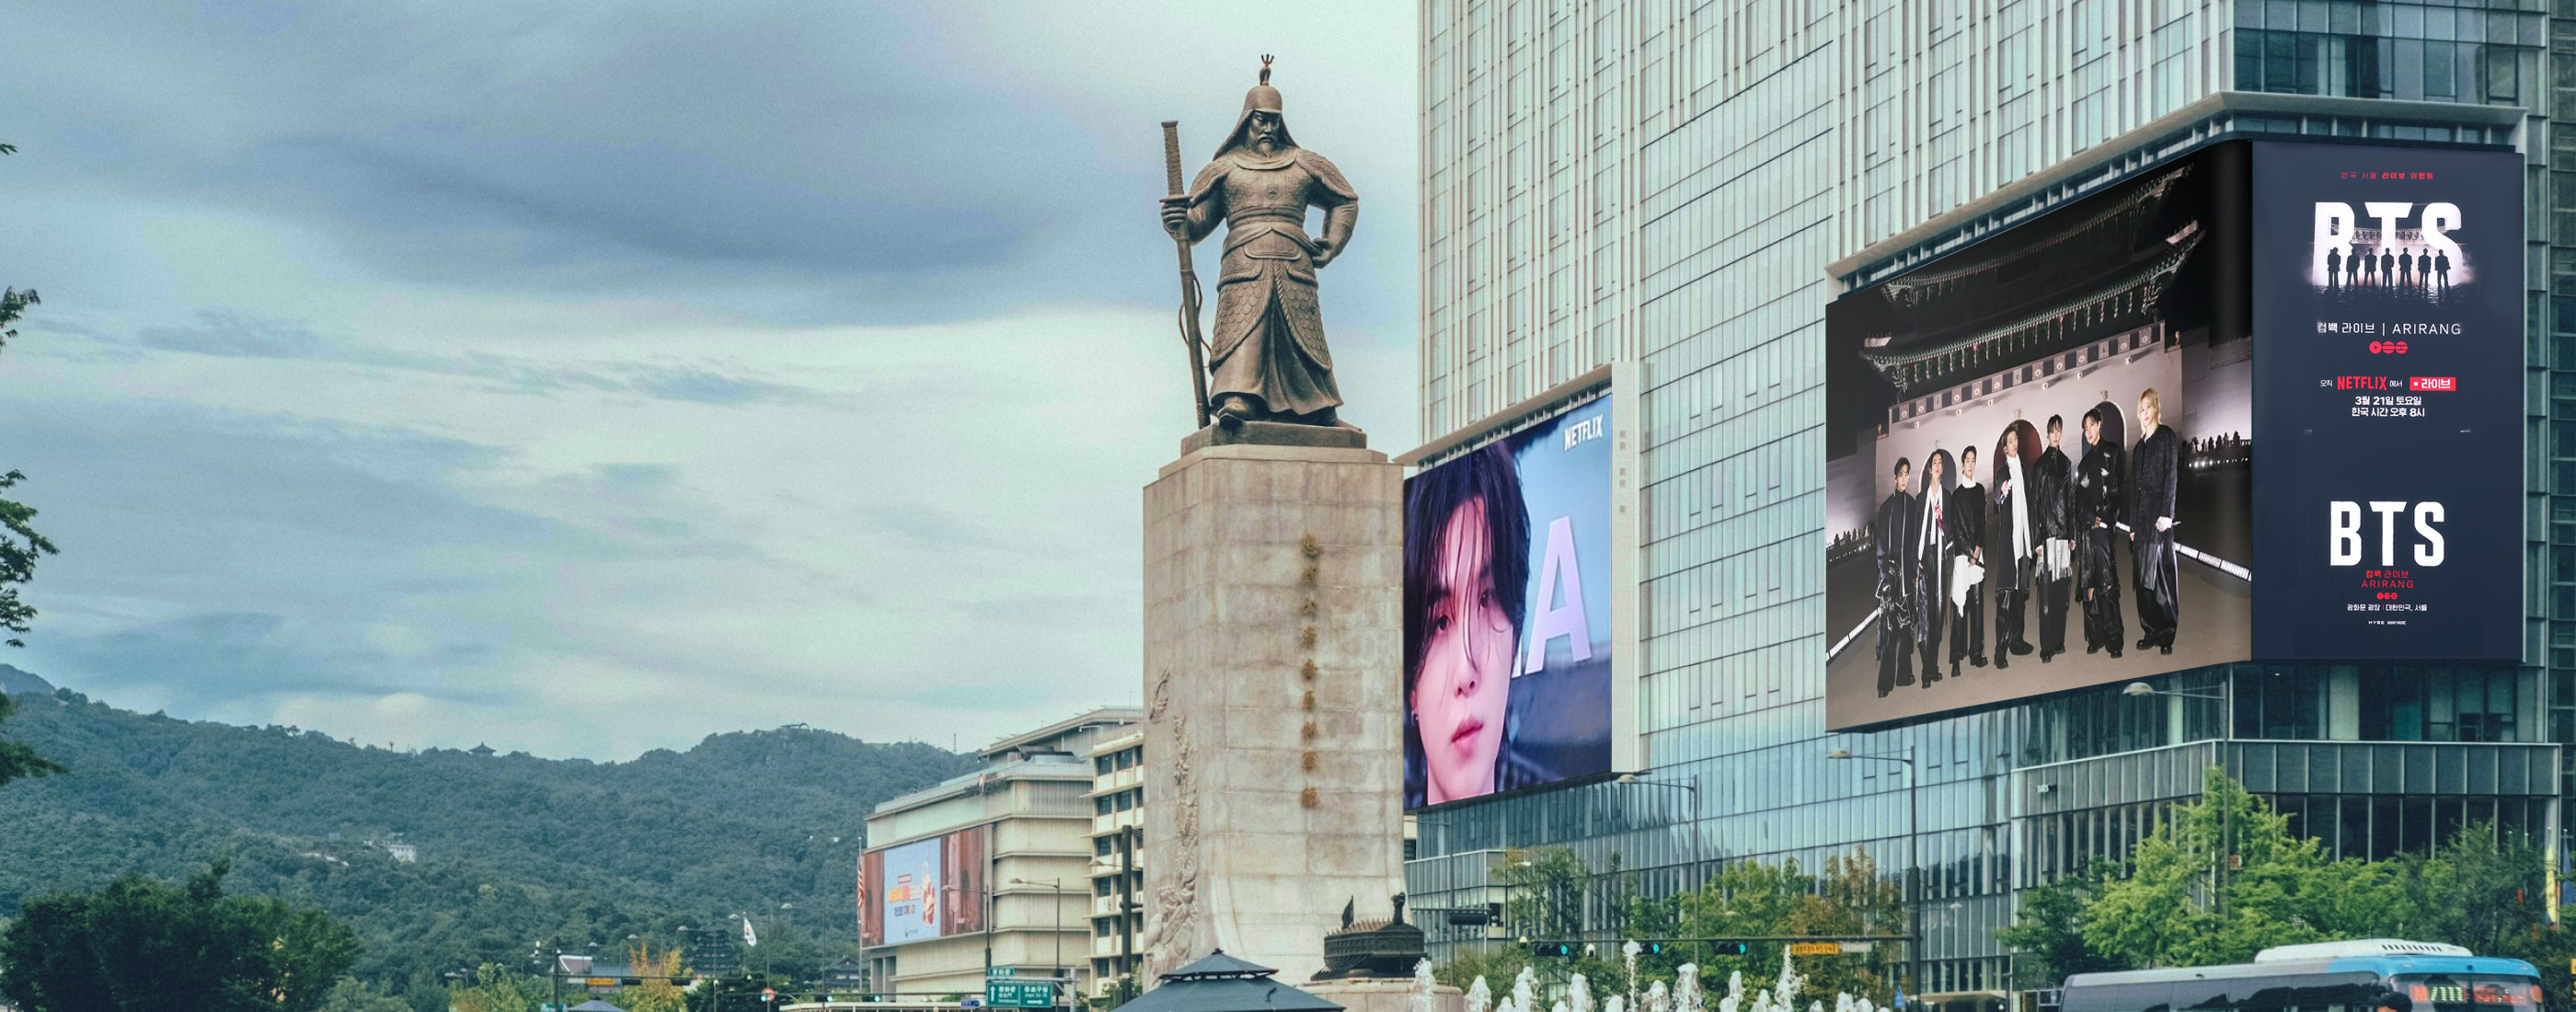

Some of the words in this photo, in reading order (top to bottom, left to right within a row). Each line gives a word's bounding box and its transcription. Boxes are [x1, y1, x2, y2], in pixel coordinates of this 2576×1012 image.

[2313, 201, 2464, 286] BTS
[2317, 323, 2337, 334] 컴백
[2342, 323, 2375, 334] 라이브
[2392, 324, 2460, 335] ARIRANG
[2338, 376, 2386, 390] NETFLIX
[2421, 379, 2450, 389] 라이브
[2355, 396, 2370, 406] 3월
[2374, 397, 2393, 406] 21일
[2397, 397, 2421, 407] 토요일
[2352, 408, 2368, 417] 한국
[2371, 408, 2388, 418] 시간
[2390, 408, 2407, 418] 오후
[2409, 408, 2424, 418] 8시
[1564, 414, 1604, 452] NETFLIX
[2330, 501, 2444, 566] BTS
[2366, 570, 2381, 579] 컴백
[2385, 570, 2409, 579] 라이브
[2362, 581, 2413, 589] ARIRANG
[1512, 514, 1593, 679] A
[2386, 604, 2413, 613] 대한민국,
